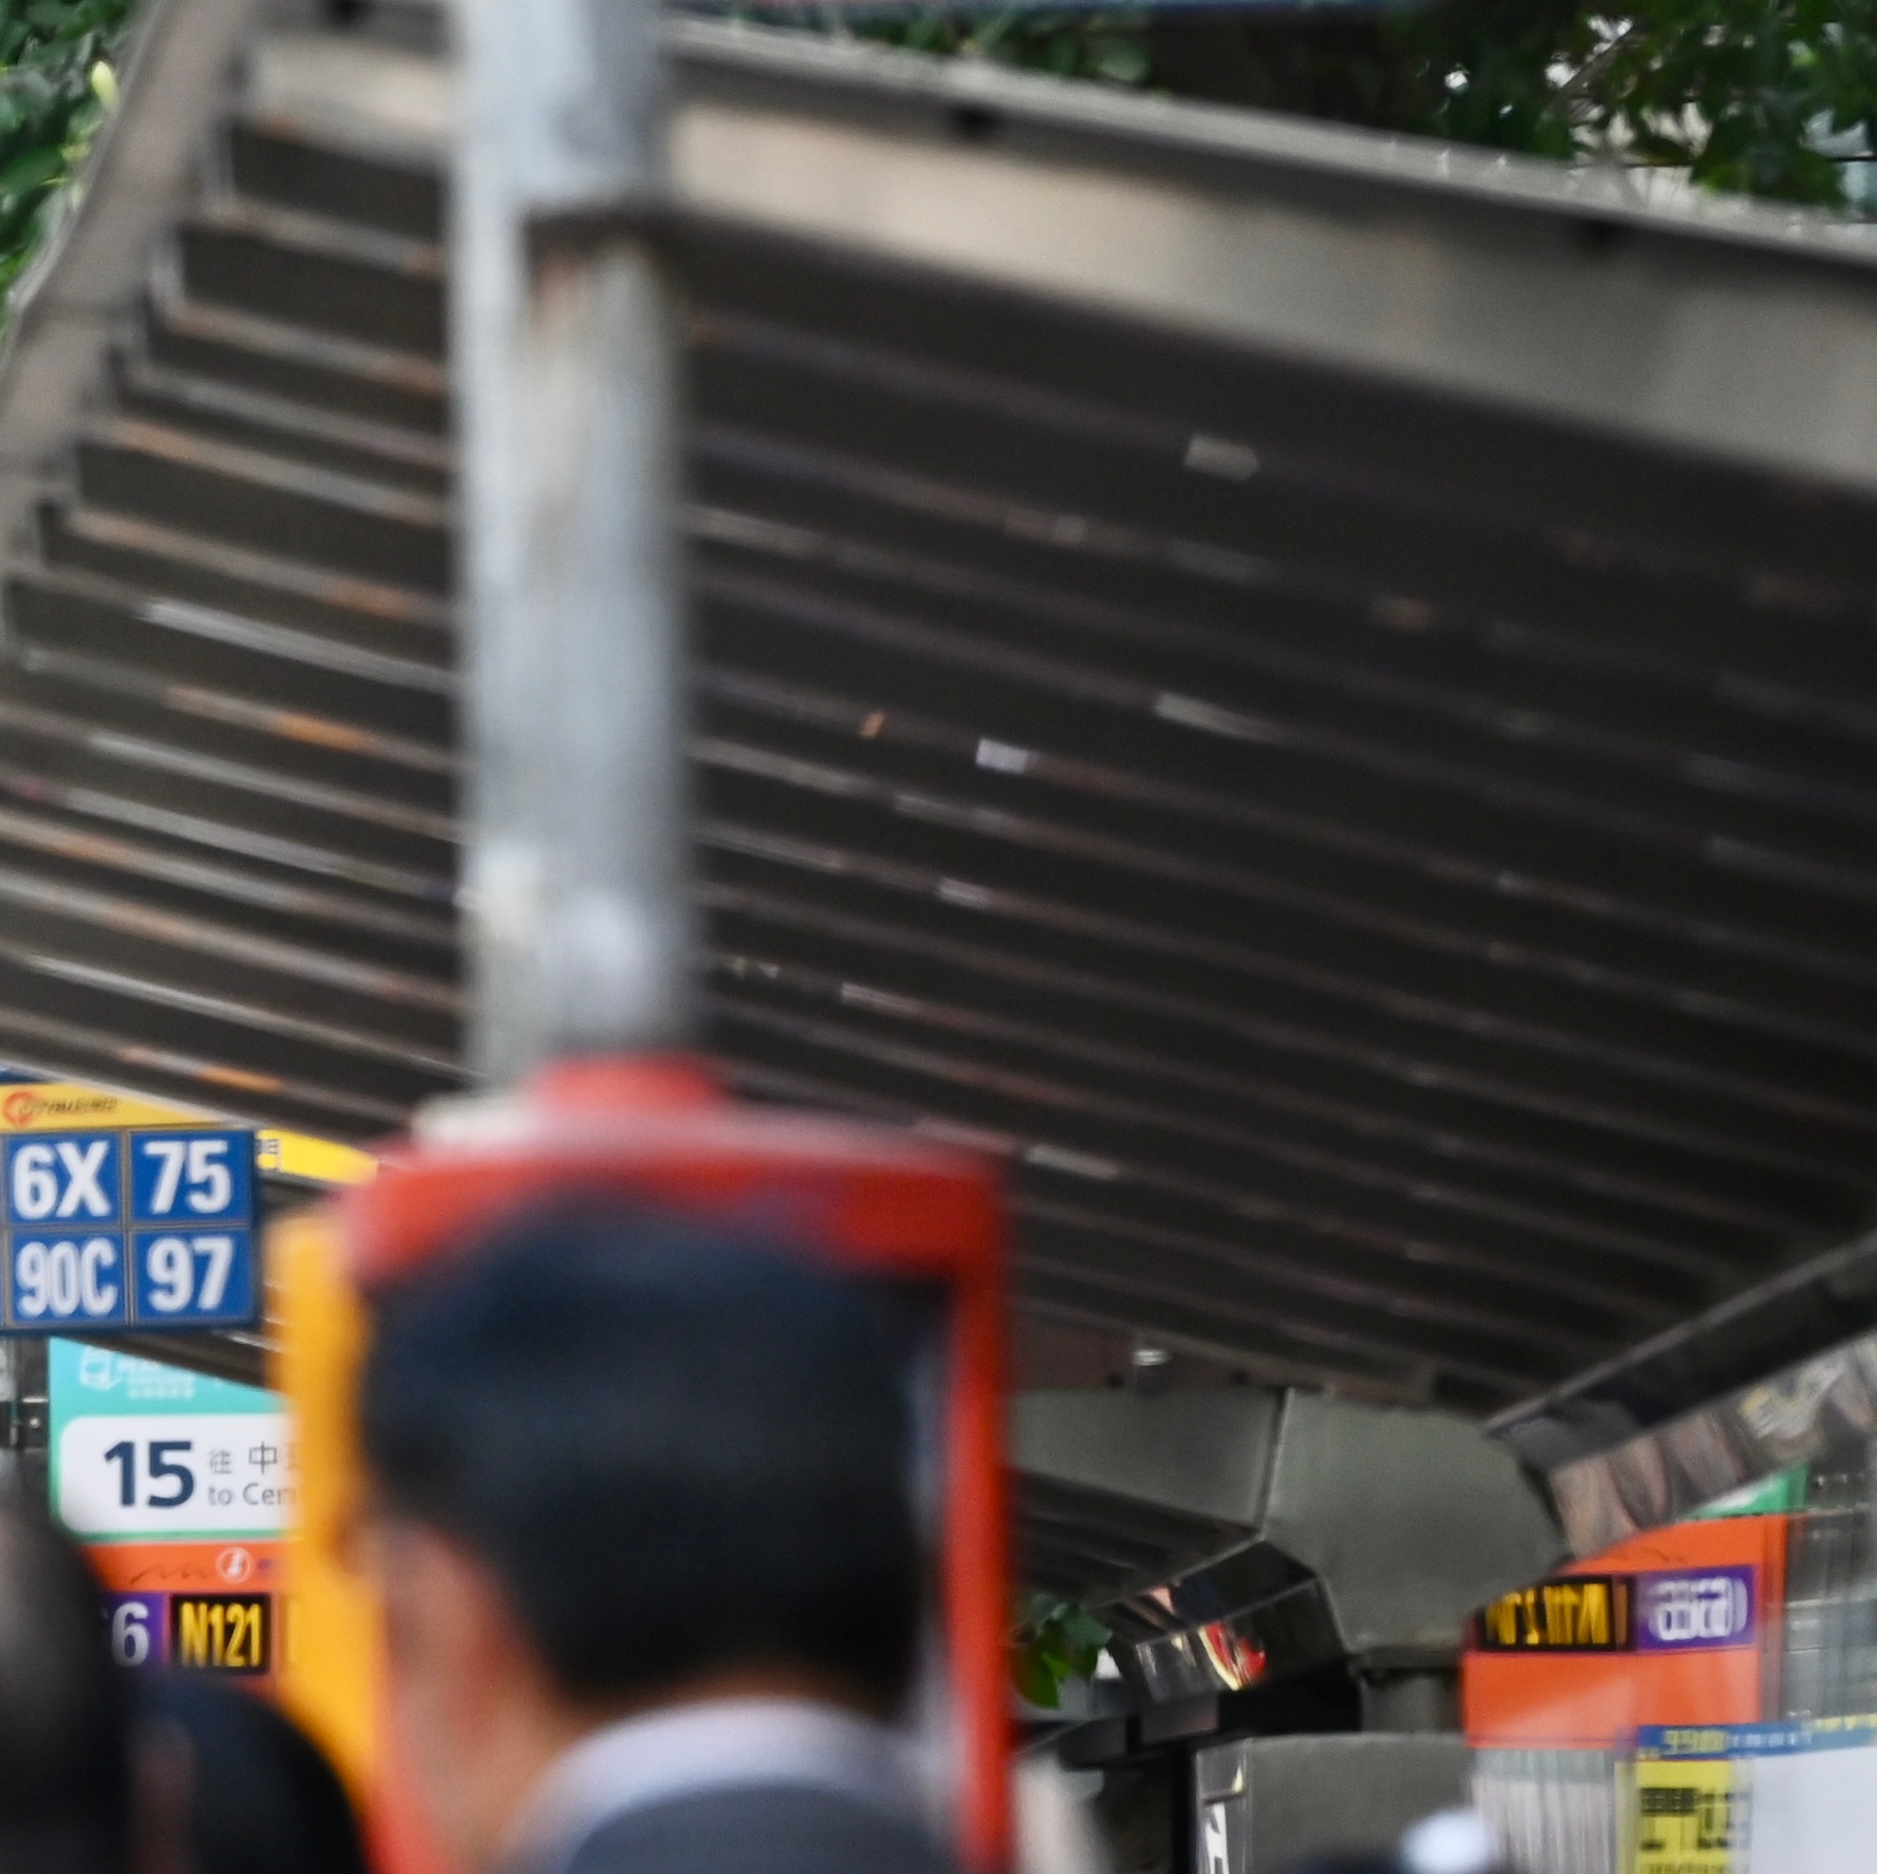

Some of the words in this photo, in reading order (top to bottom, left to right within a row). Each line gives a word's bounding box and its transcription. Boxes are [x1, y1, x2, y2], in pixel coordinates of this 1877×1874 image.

[12, 1141, 112, 1221] 6X
[144, 1139, 233, 1214] 75
[15, 1237, 118, 1318] 90C
[147, 1236, 235, 1314] 97
[103, 1440, 196, 1509] 15
[208, 1485, 233, 1506] to
[179, 1601, 264, 1668] N121
